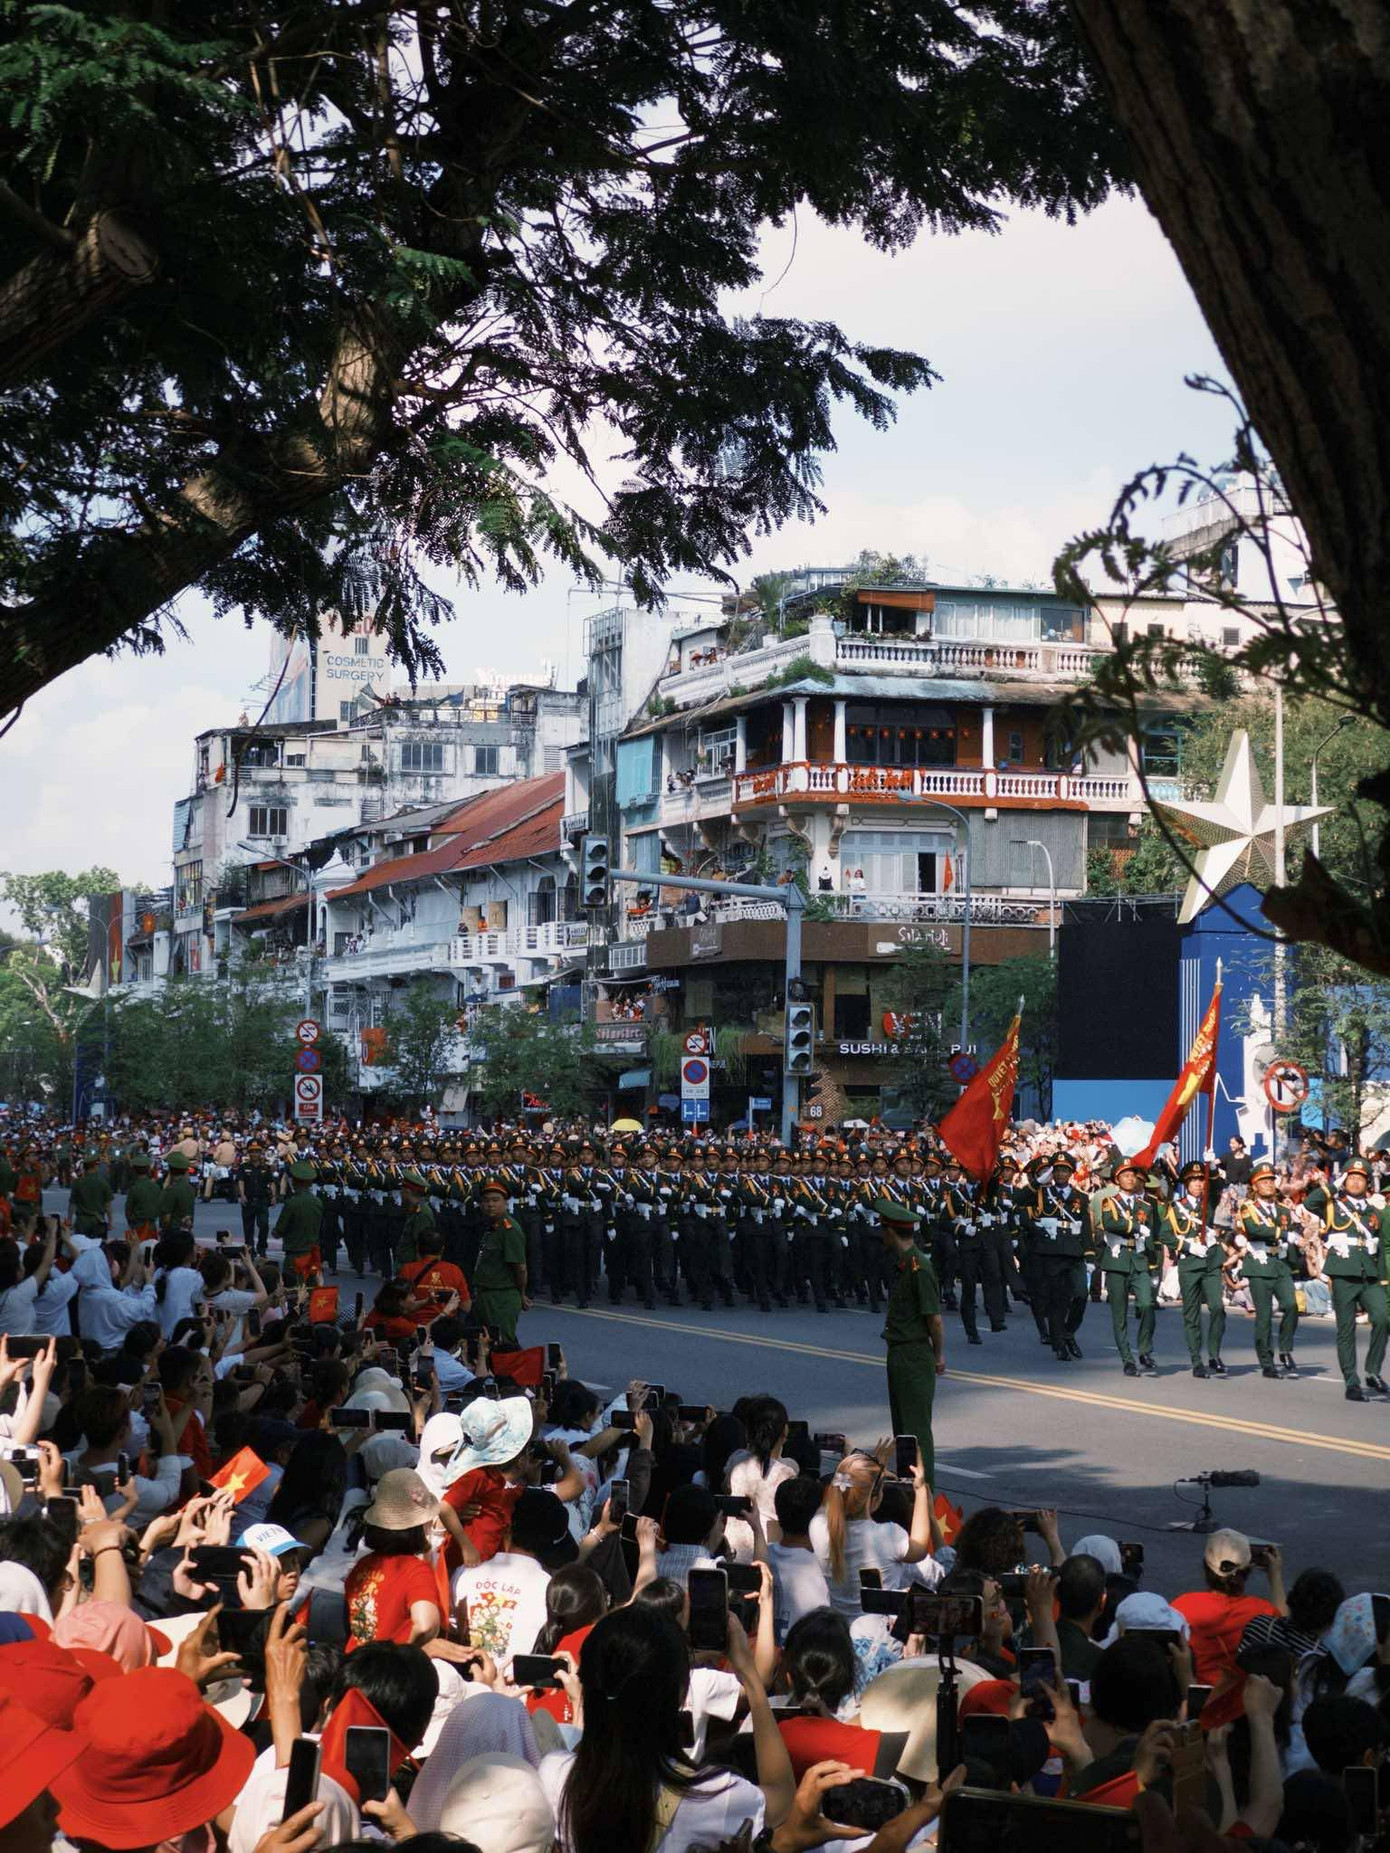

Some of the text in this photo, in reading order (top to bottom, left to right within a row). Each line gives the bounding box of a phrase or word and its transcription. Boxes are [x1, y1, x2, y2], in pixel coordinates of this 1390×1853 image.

[327, 656, 384, 669] COSMETIC
[327, 669, 384, 682] SURGERY
[839, 1043, 888, 1055] SUSHI
[810, 1106, 822, 1117] 68
